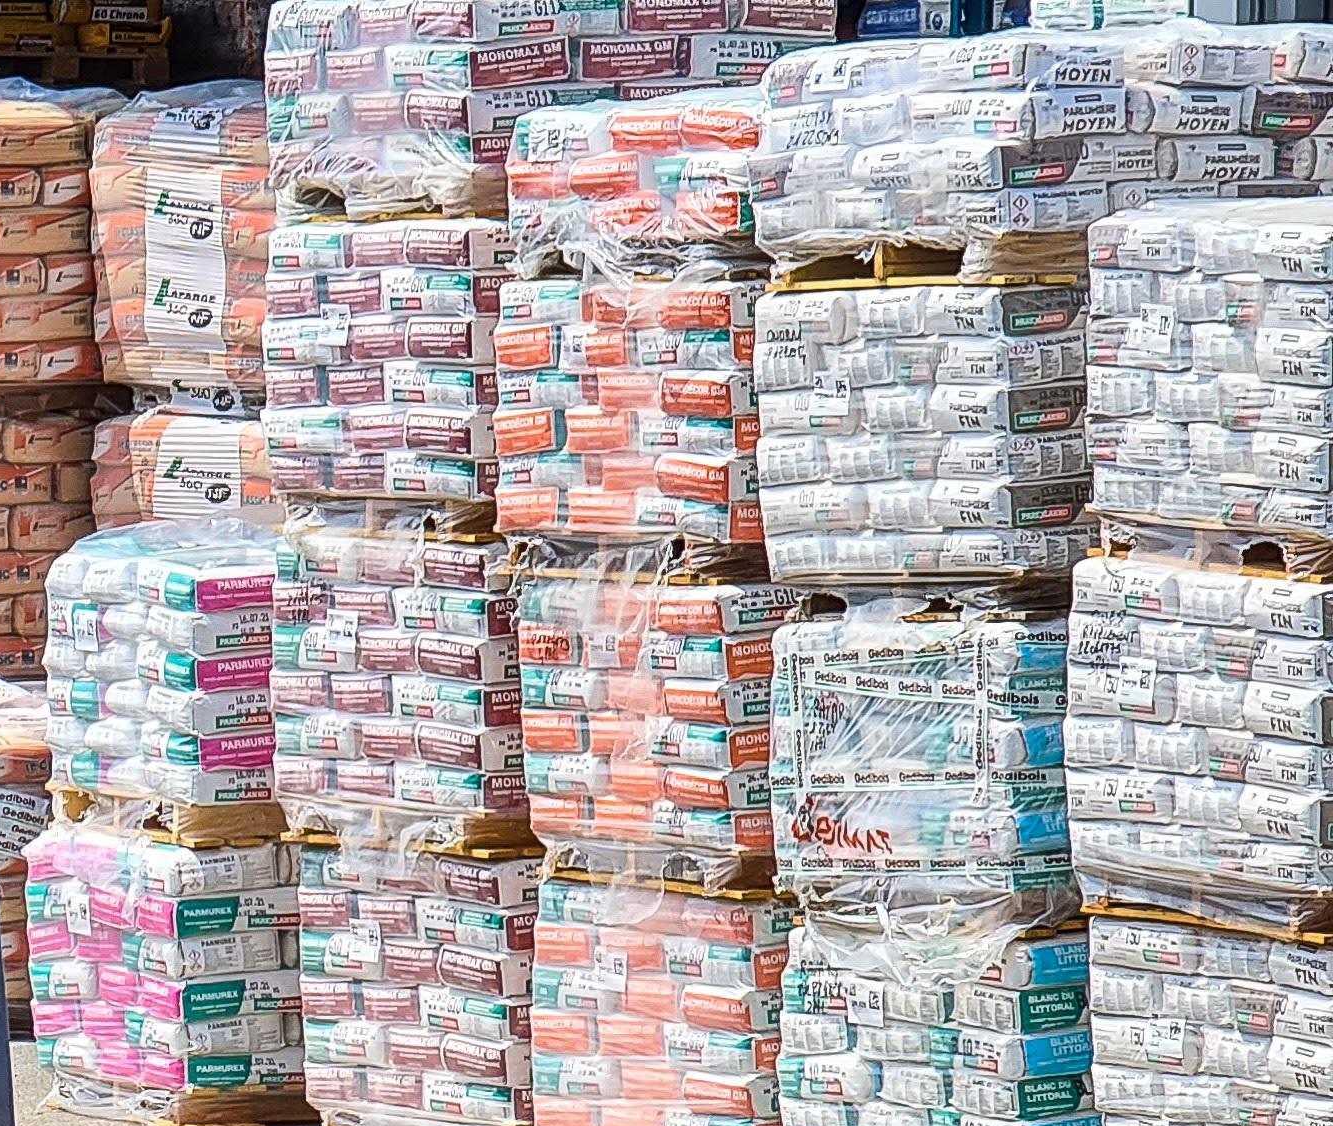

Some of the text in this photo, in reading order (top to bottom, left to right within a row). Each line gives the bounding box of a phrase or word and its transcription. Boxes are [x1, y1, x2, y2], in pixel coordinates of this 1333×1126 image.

[477, 40, 563, 63] MONOMAX GM
[590, 39, 673, 55] MONOMAX GM
[1055, 69, 1111, 82] MOYEN
[1062, 117, 1117, 132] MOYEN
[1176, 118, 1229, 130] MOYEN
[1117, 159, 1154, 169] MOYEN
[1202, 167, 1259, 179] MOYEN
[1146, 247, 1161, 257] FIN
[1281, 258, 1303, 272] FIN
[955, 316, 976, 330] FIN
[970, 363, 985, 374] FIN
[1282, 361, 1303, 376] FIN
[959, 415, 981, 427] FIN
[1297, 411, 1312, 422] FIN
[970, 459, 985, 471] FIN
[1278, 463, 1300, 480] FIN
[960, 510, 984, 524] FIN
[974, 552, 990, 562] FIN
[1270, 613, 1294, 629] FIN
[1287, 665, 1303, 676] FIN
[987, 690, 1039, 705] Gedibois
[1270, 717, 1294, 733] FIN
[991, 771, 1047, 782] Gedibois
[1281, 769, 1297, 781] FIN
[1267, 821, 1291, 835] FIN
[183, 907, 233, 918] PARMUREX
[1057, 953, 1087, 965] LITTO
[1295, 969, 1320, 985] FIN
[190, 990, 238, 1002] PARMUREX
[1028, 991, 1075, 1005] BLANC DU
[1030, 1001, 1076, 1013] LITTORAL
[1308, 1022, 1325, 1034] FIN
[1052, 1044, 1091, 1056] LITTOR
[196, 1064, 245, 1074] PARMUREX
[1295, 1073, 1319, 1088] FIN
[1024, 1081, 1072, 1093] BLANC DU
[1026, 1091, 1073, 1102] LITTORAL
